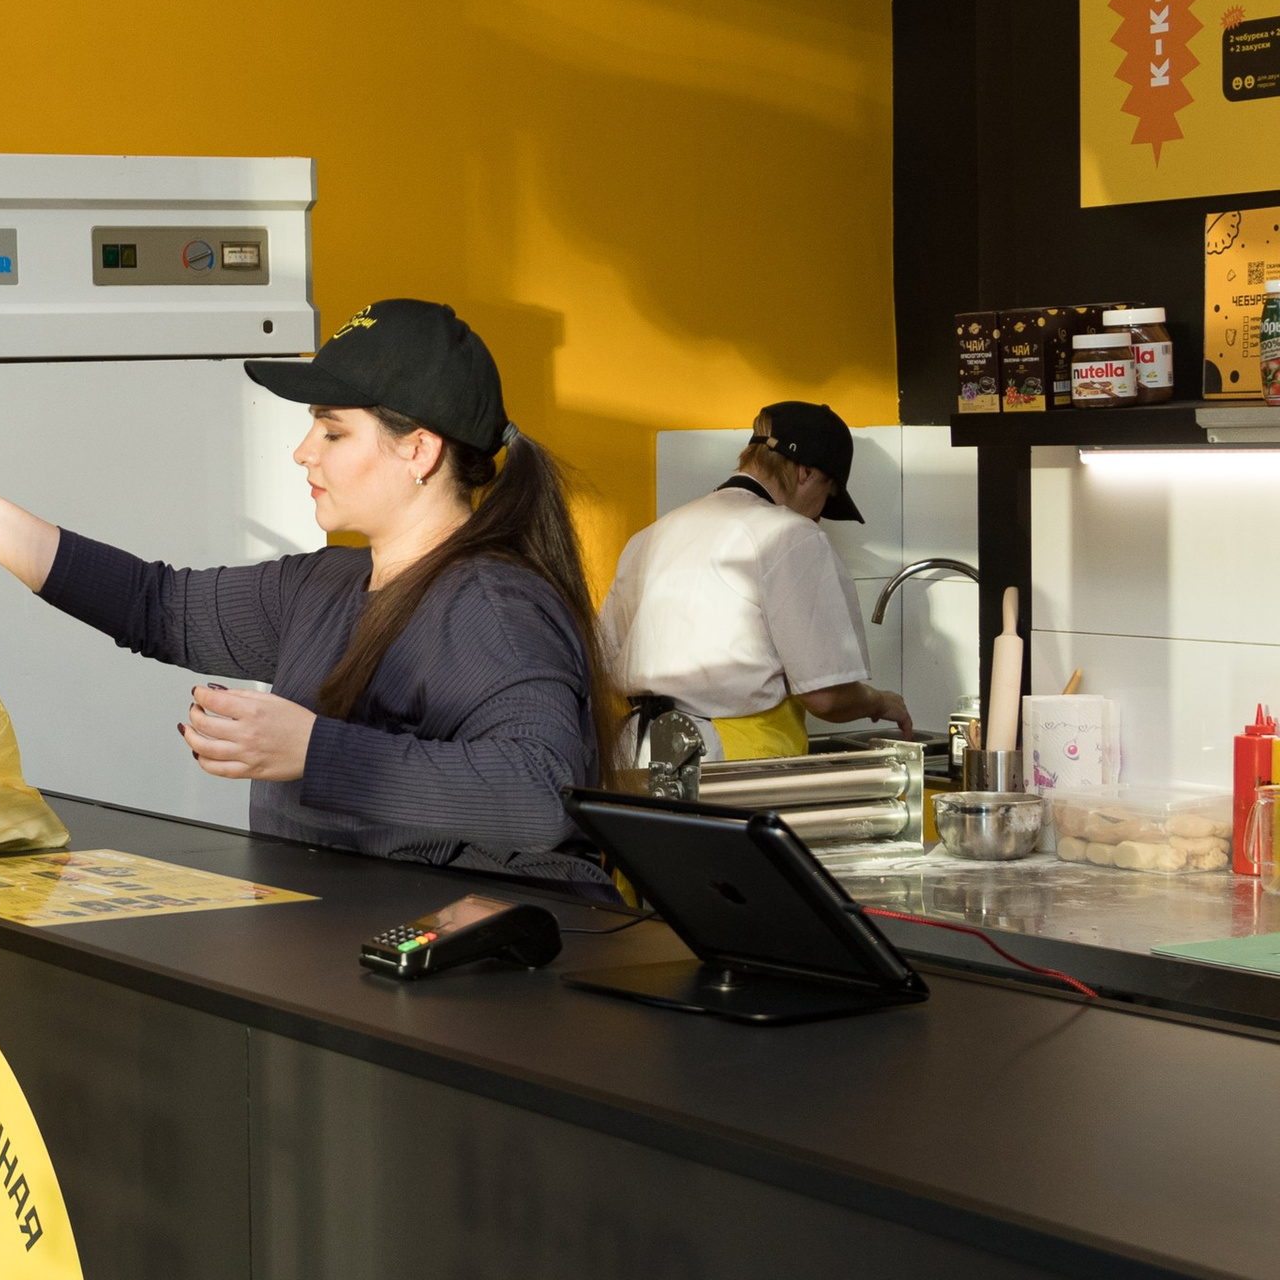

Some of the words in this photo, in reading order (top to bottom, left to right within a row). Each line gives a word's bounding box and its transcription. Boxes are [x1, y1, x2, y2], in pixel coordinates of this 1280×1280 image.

[1235, 31, 1269, 42] чебурека
[1242, 41, 1271, 52] закуски
[965, 337, 985, 352] ЧАЙ
[1011, 342, 1030, 356] ЧАЙ
[1073, 362, 1126, 380] nutella
